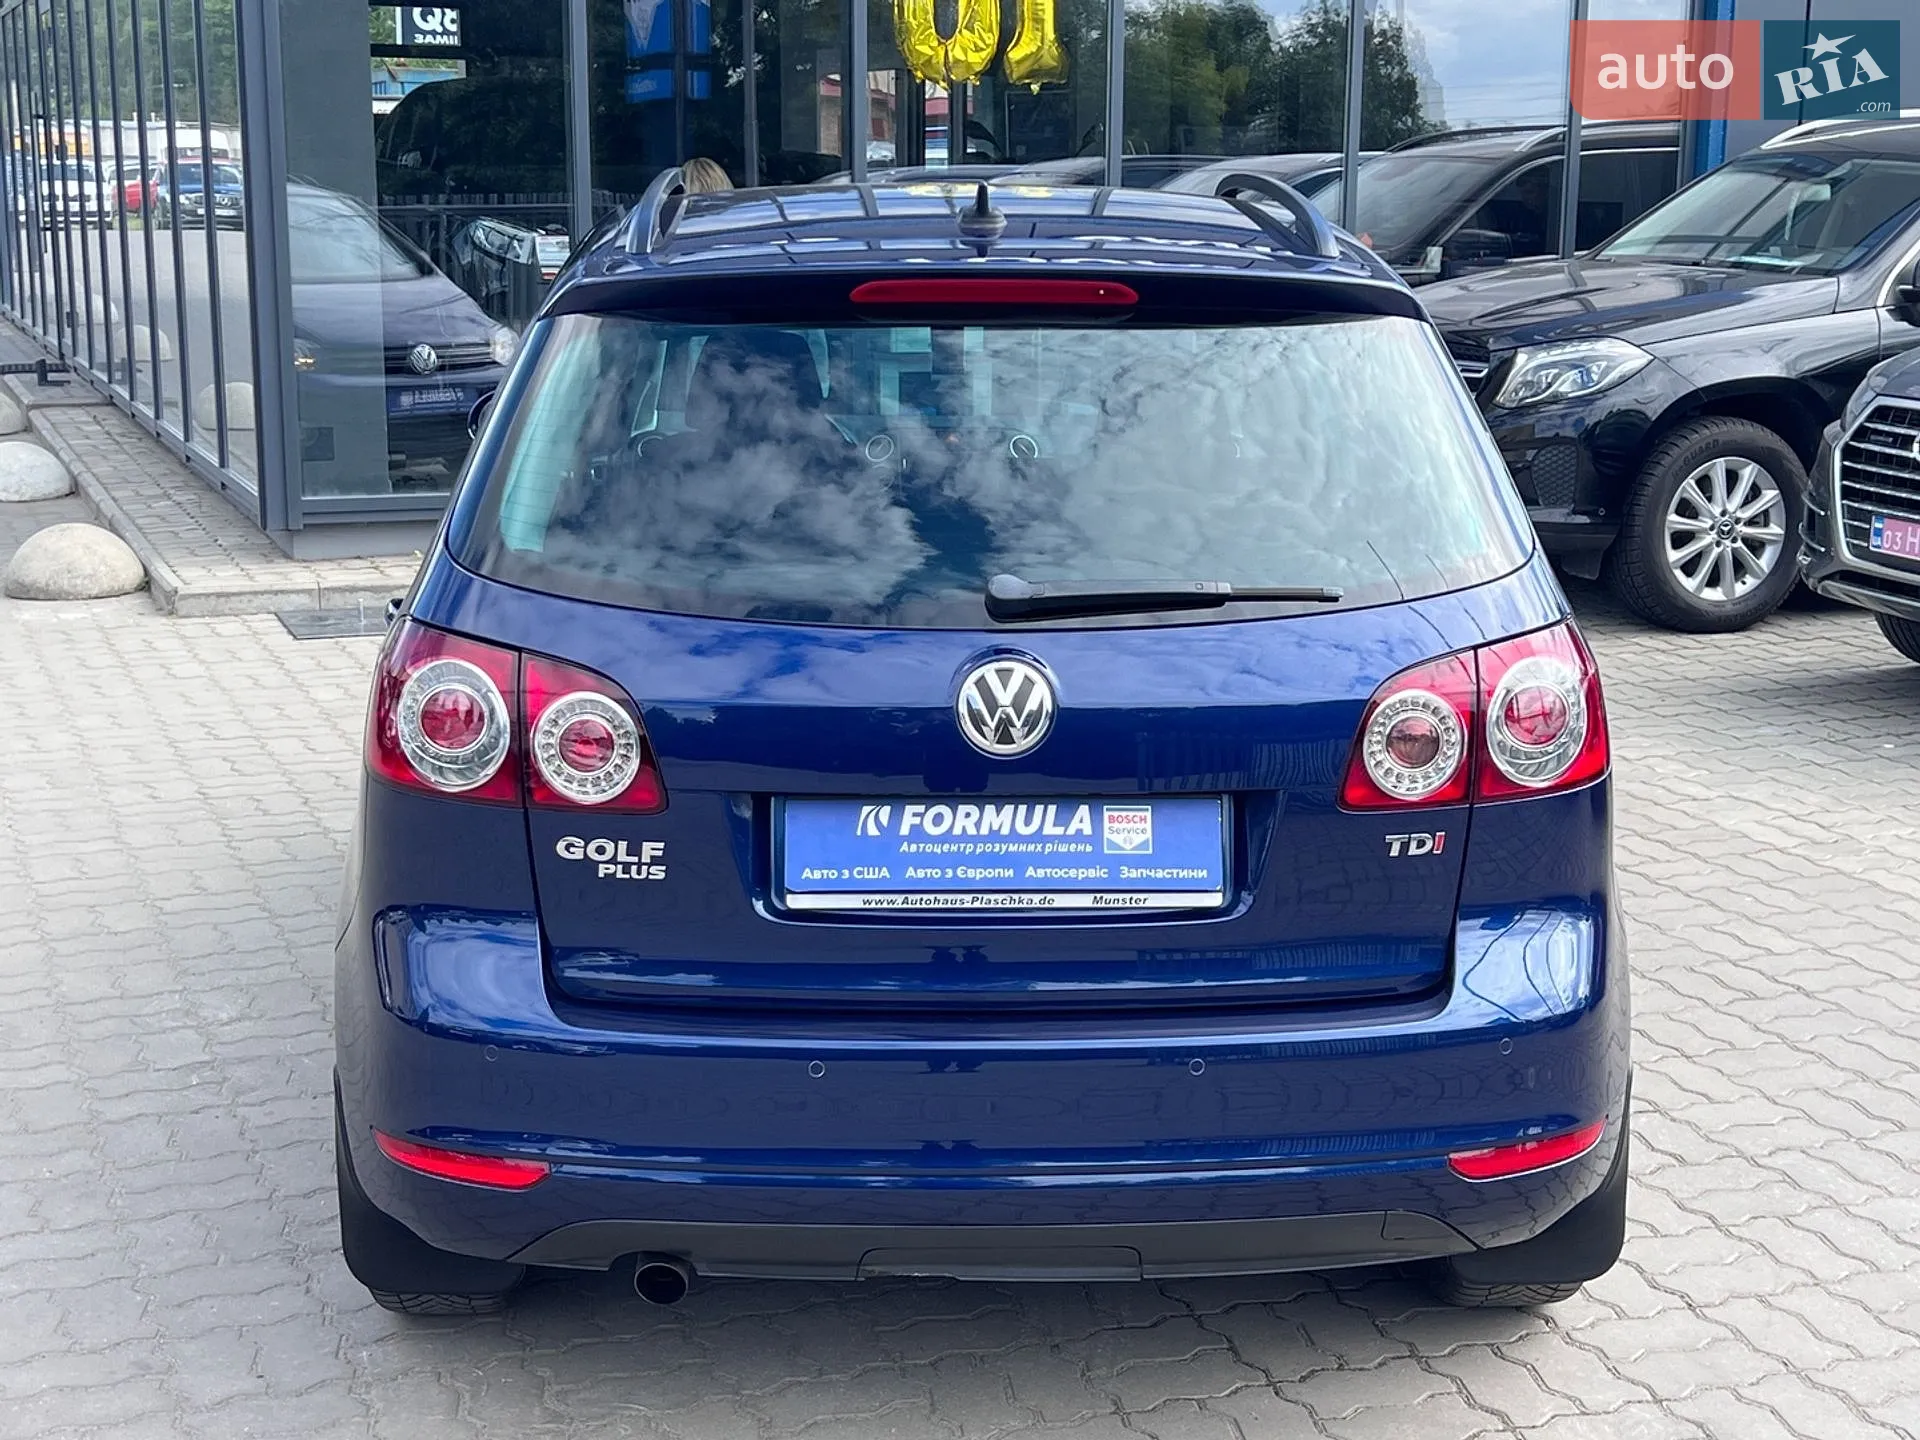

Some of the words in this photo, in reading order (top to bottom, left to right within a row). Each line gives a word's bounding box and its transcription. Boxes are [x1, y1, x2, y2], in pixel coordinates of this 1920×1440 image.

[1883, 530, 1903, 551] 03
[957, 660, 1053, 755] VW
[899, 804, 1093, 836] FORMULA
[1107, 814, 1148, 825] BOSCH
[1108, 826, 1148, 836] Service
[555, 835, 665, 863] GOLF
[899, 840, 975, 855] Автоцентр
[975, 842, 1043, 855] розумних
[1044, 839, 1094, 855] рішень
[597, 863, 667, 880] PLUS
[801, 867, 838, 880] Авто
[841, 868, 850, 879] з
[853, 866, 891, 879] США
[905, 866, 941, 879] Авто
[945, 868, 953, 879] з
[956, 865, 1015, 881] Європи
[1025, 864, 1109, 880] Автосервіс
[1119, 865, 1208, 880] Запчастини
[862, 895, 1056, 907] www.Autohaus-Plaschka.de
